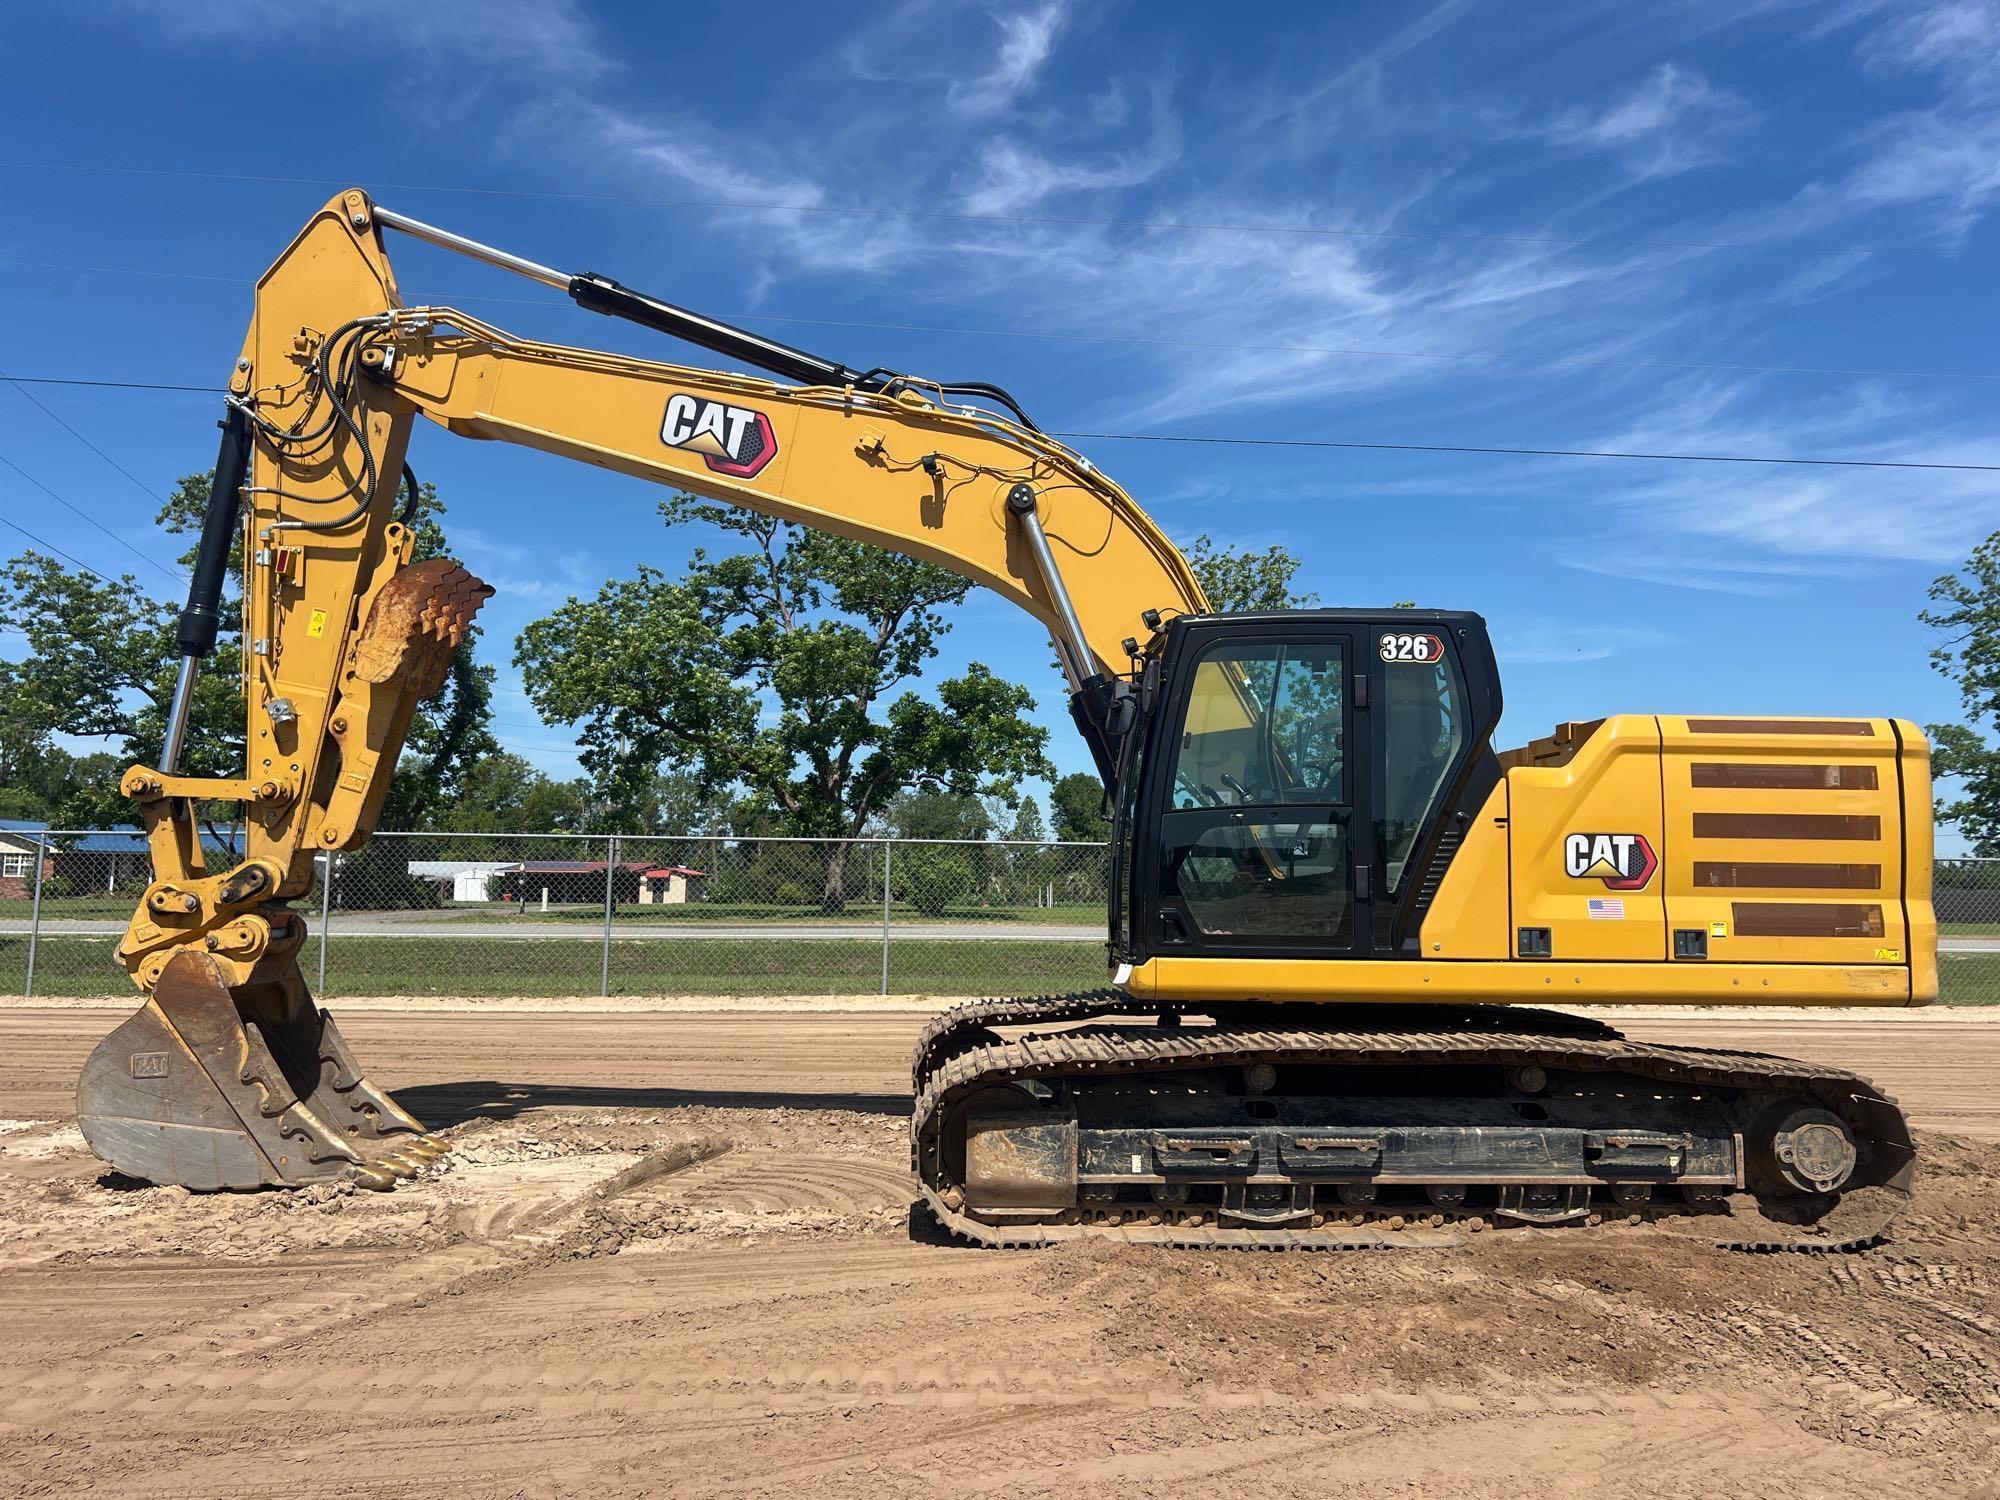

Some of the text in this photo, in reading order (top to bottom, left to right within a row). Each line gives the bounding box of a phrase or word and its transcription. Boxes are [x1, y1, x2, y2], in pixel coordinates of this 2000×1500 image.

[662, 394, 756, 460] CAT
[1382, 635, 1428, 660] 326
[1566, 834, 1635, 877] CAT
